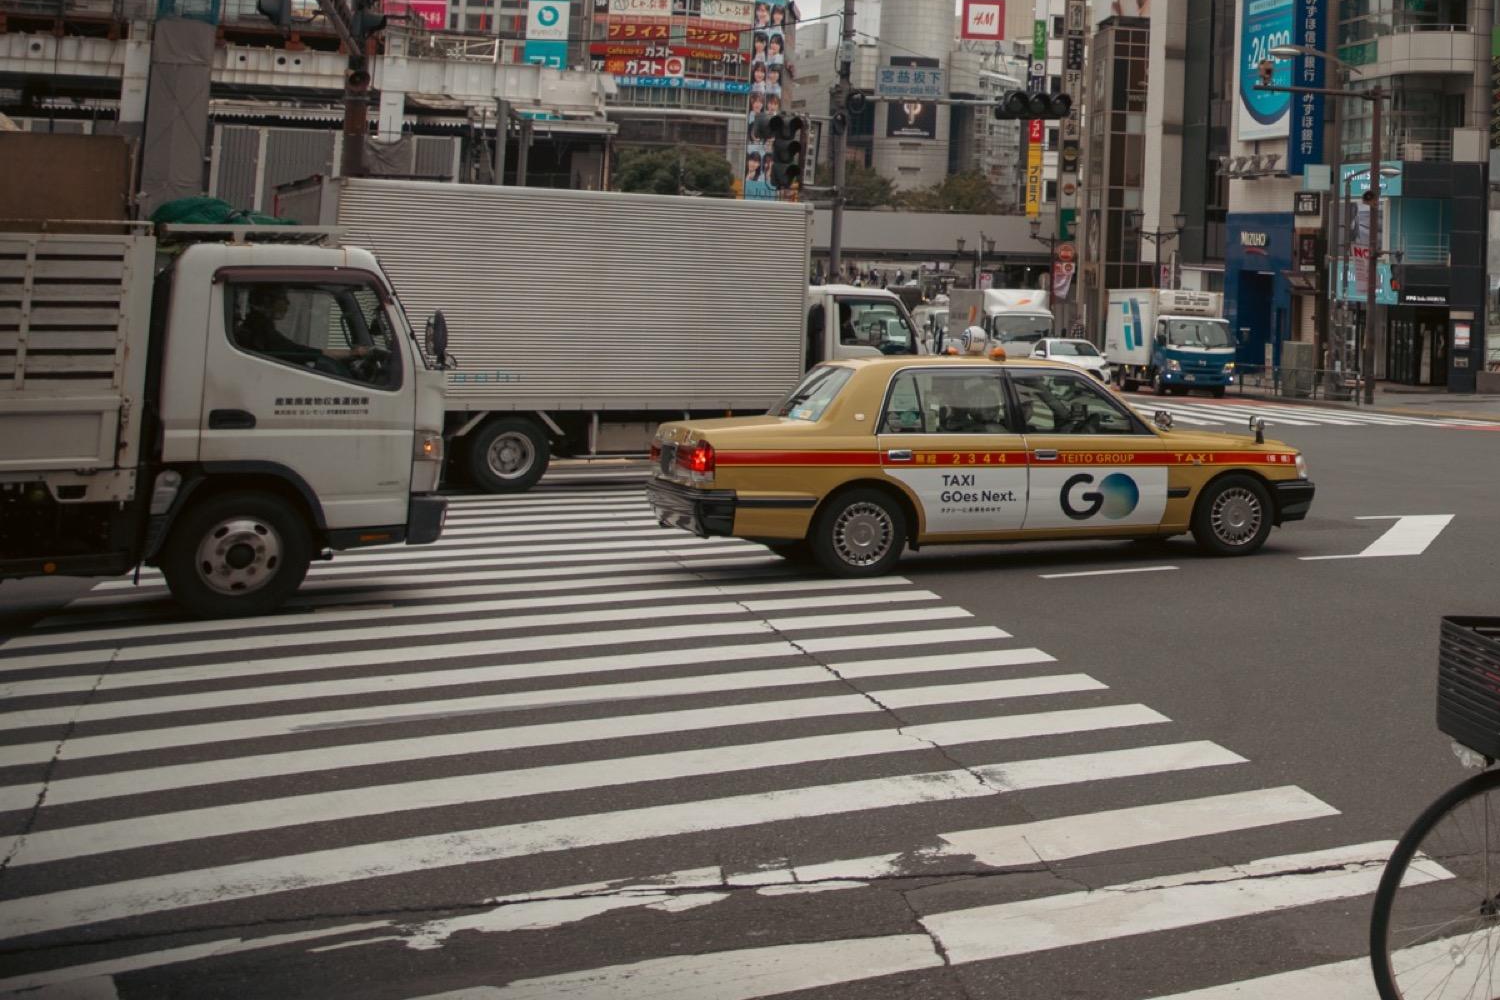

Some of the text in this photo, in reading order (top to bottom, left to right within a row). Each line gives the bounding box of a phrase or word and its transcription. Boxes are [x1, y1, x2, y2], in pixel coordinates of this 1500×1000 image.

[609, 24, 668, 38] プライス
[626, 59, 662, 74] ガスト
[1302, 90, 1315, 154] みずほ銀行
[1061, 453, 1135, 464] TEITO GROUP
[1175, 453, 1215, 463] TAXI
[941, 475, 975, 486] TAXI
[941, 490, 1017, 502] GOes Next.
